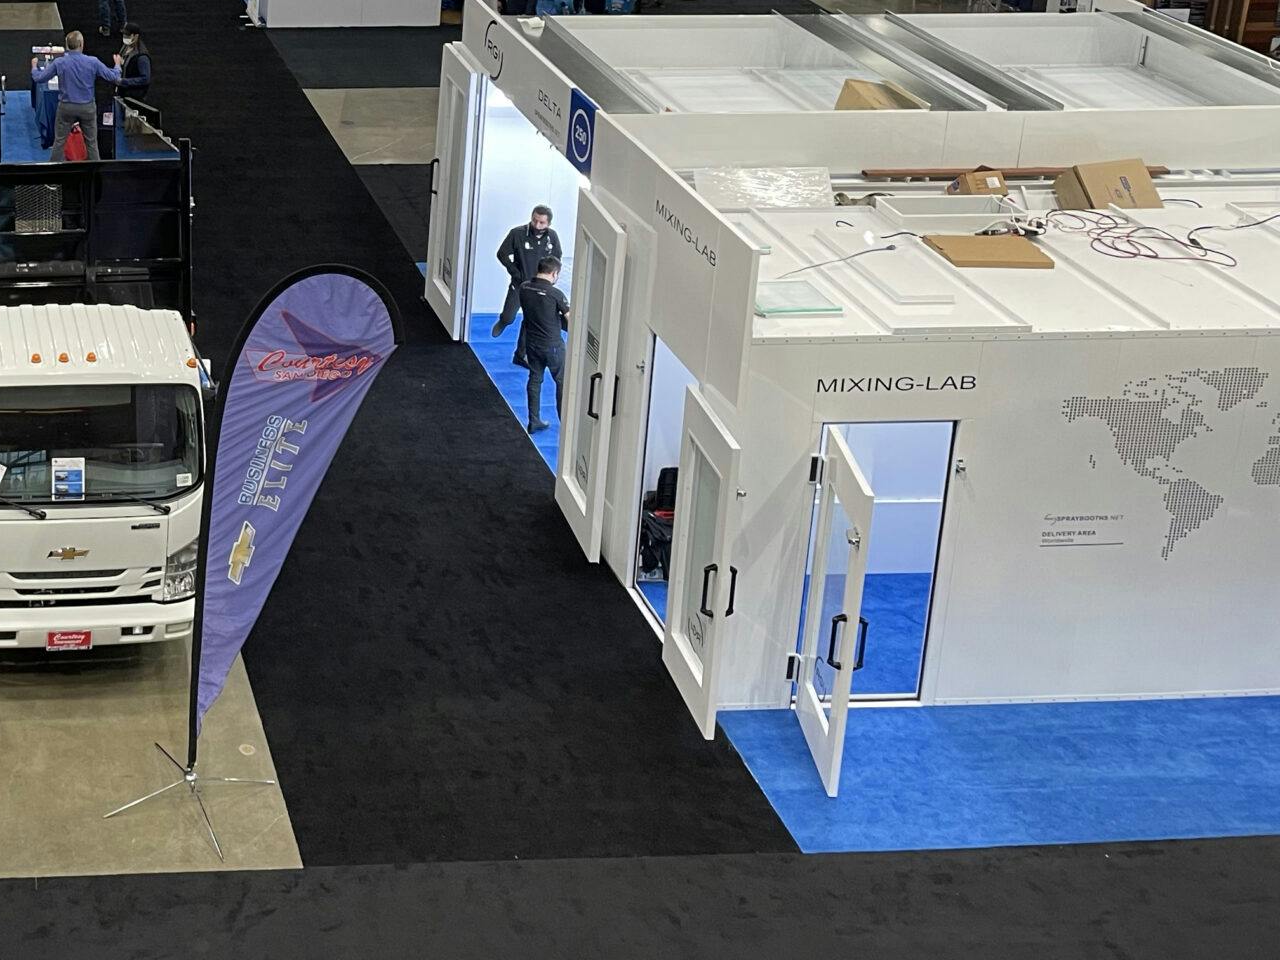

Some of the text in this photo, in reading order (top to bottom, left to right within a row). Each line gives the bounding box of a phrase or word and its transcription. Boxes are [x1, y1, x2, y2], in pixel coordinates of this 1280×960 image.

[537, 90, 562, 120] DELTA
[575, 125, 587, 145] 250
[655, 199, 717, 267] MIXING-LAB
[257, 350, 375, 375] Courtesy
[816, 375, 977, 393] MIXING-LAB
[238, 414, 283, 506] BUSINESS
[257, 418, 308, 513] ELITE
